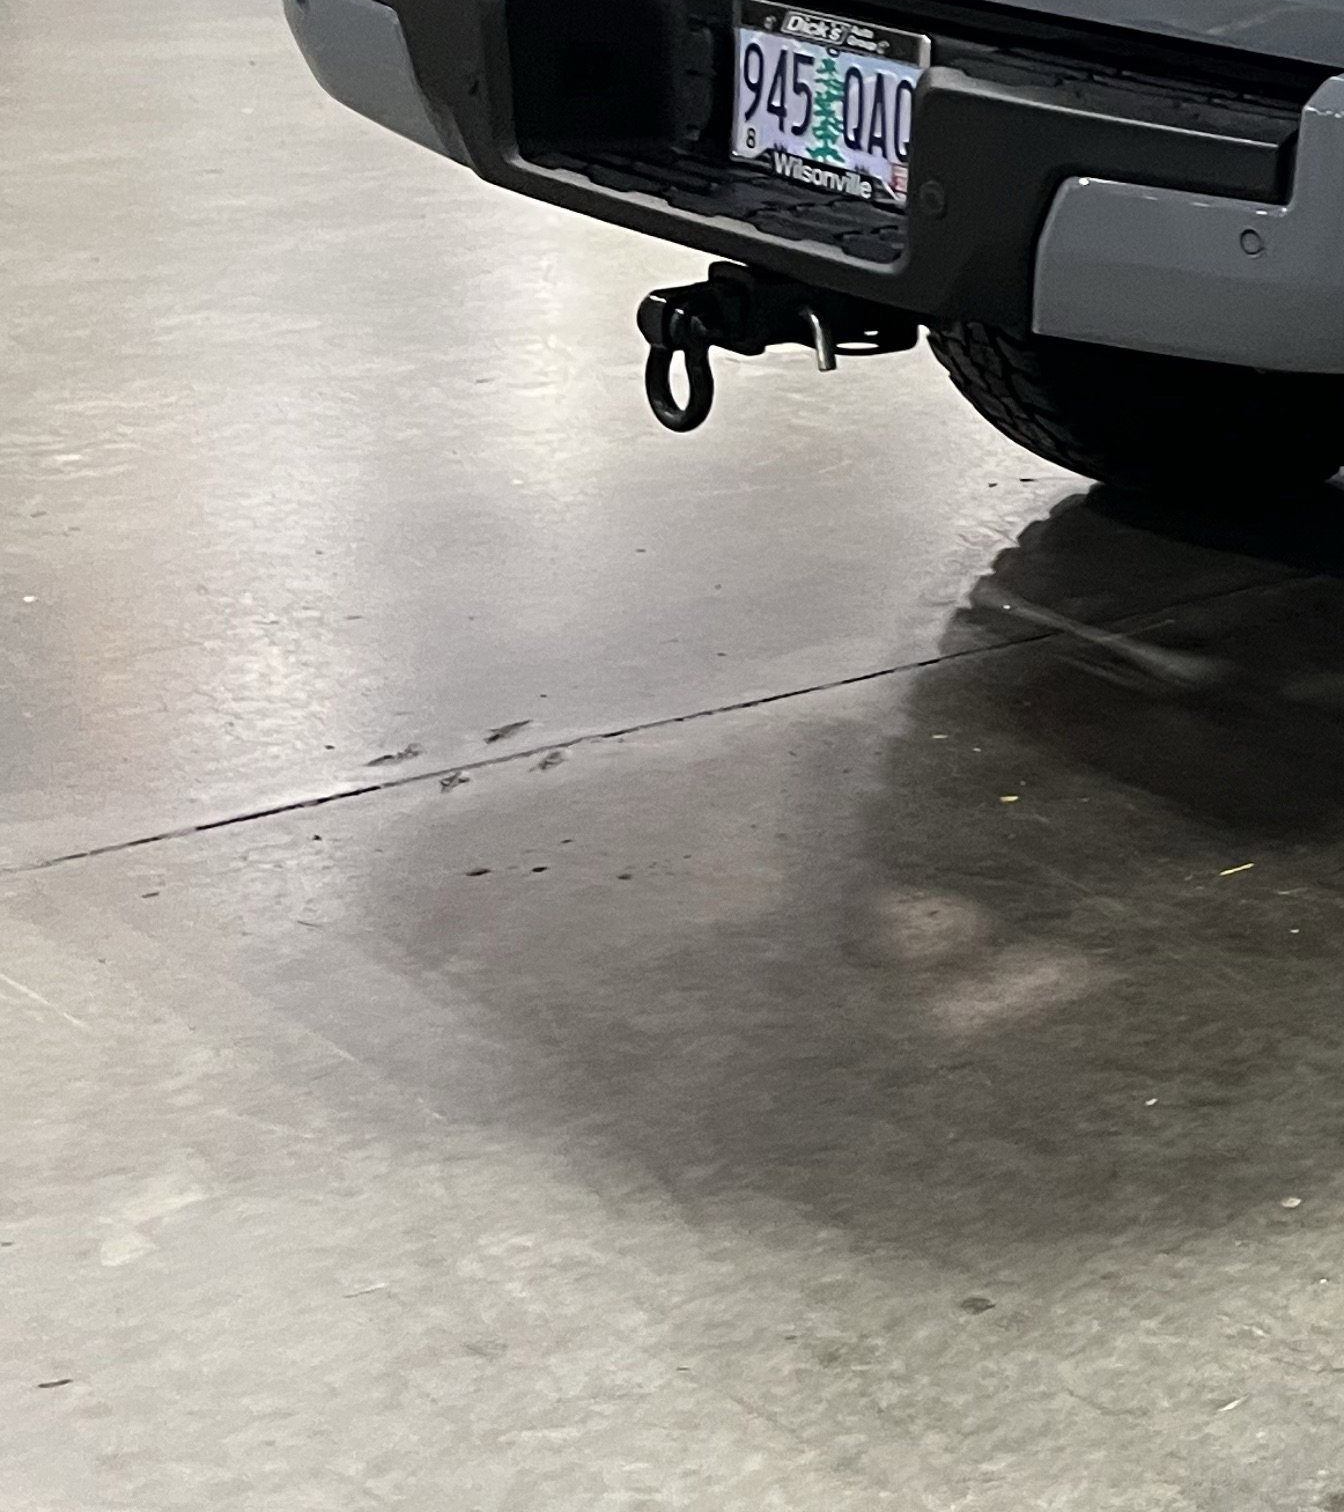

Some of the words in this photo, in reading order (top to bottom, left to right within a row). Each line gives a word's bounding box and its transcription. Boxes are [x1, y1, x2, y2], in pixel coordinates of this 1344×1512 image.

[786, 15, 842, 41] Dick's
[743, 42, 815, 136] 945
[746, 127, 756, 149] 8
[773, 151, 872, 199] Wilsonville
